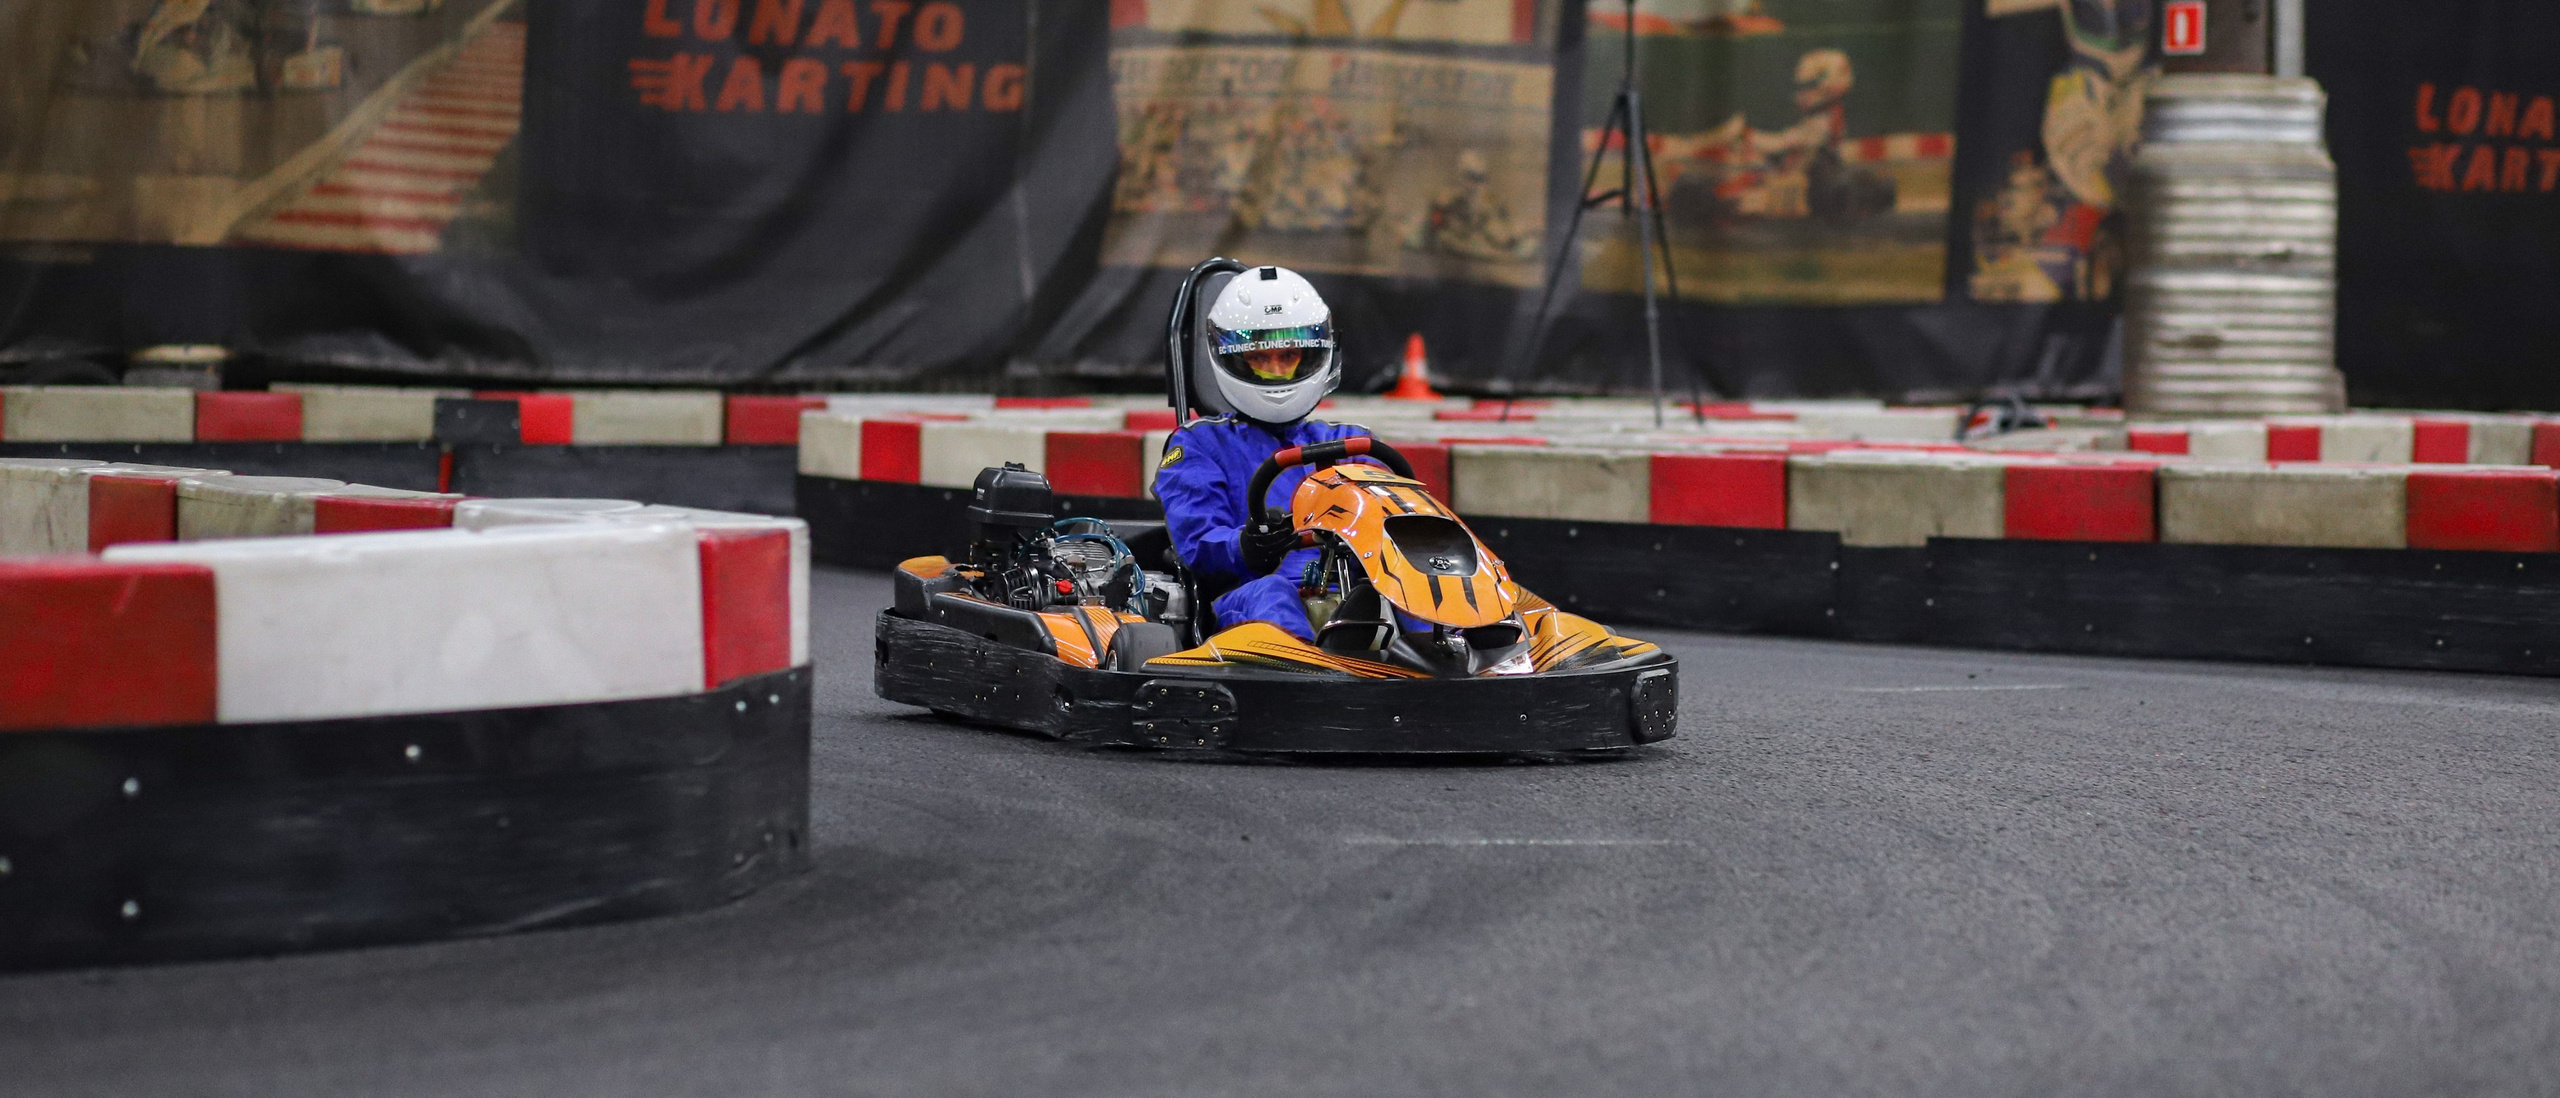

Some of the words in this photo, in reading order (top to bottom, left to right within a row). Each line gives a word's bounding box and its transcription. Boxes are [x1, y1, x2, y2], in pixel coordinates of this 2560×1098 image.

[643, 0, 965, 52] LONATO
[629, 52, 1028, 113] KARTING
[2416, 81, 2555, 140] LONA
[2408, 142, 2560, 192] KART
[1228, 342, 1256, 353] TUNEC
[1258, 339, 1291, 350] TUNEC
[1293, 339, 1320, 348] TUNEC
